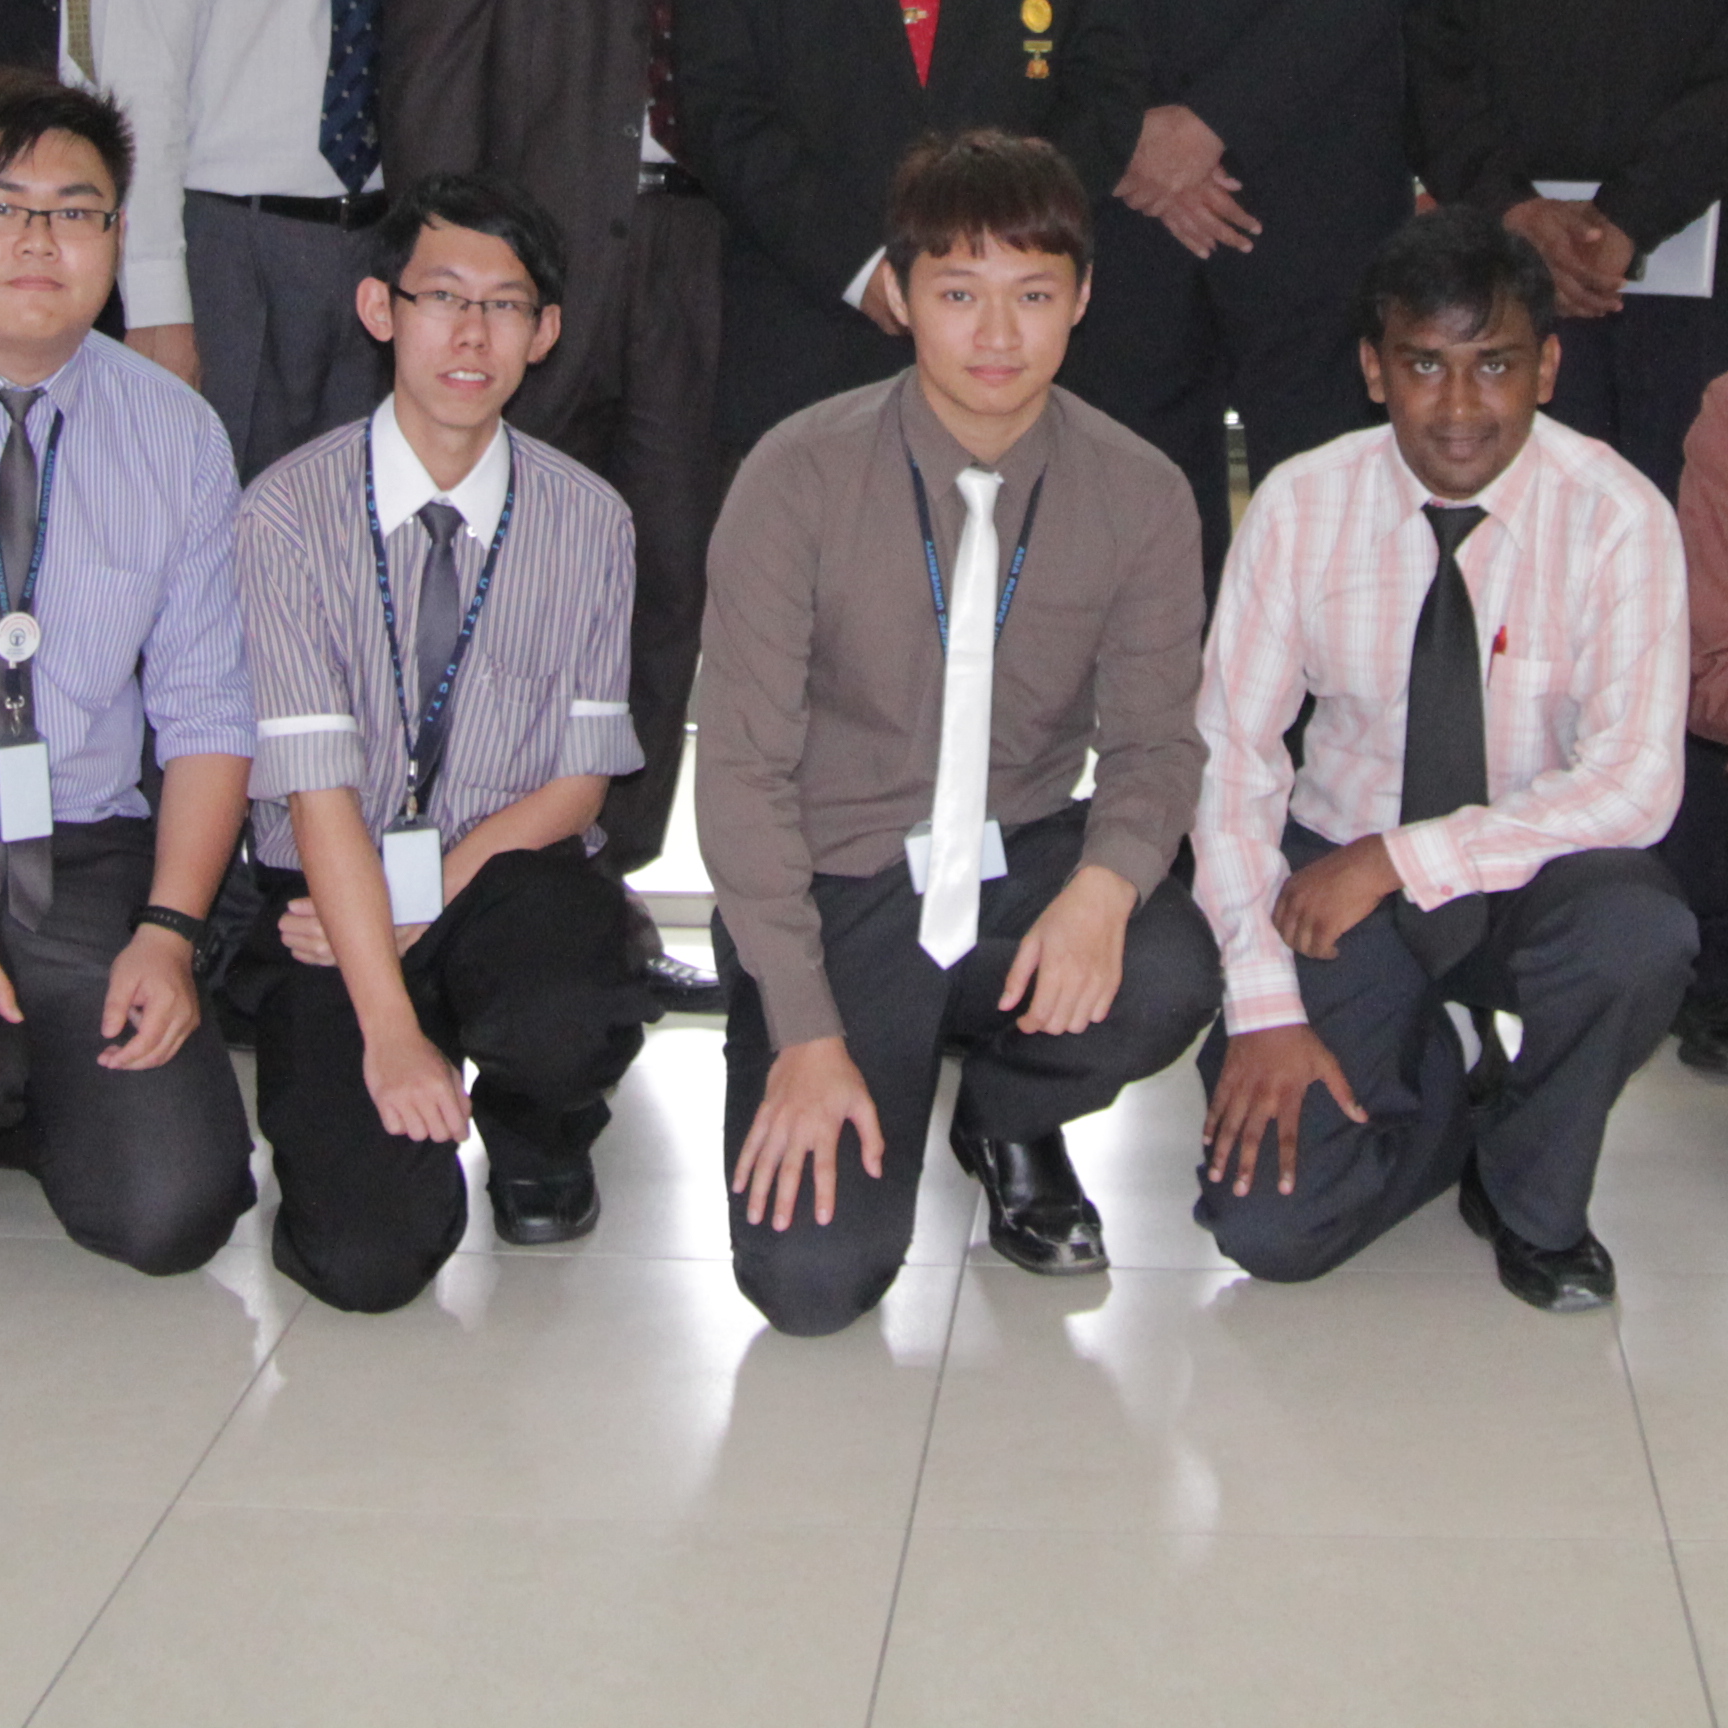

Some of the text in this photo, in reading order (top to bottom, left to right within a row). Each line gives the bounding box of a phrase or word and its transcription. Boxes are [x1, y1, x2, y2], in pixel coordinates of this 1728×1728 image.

[23, 449, 55, 599] ASIA PACIFIC UNIVERSITY
[366, 470, 379, 530] UCTI
[492, 492, 514, 549] UCTI
[926, 541, 944, 611] UNIVERSITY
[1011, 546, 1025, 574] ASIA
[377, 561, 394, 622] UCTI
[462, 578, 489, 635] UCTI
[997, 578, 1017, 624] PACIFIC
[426, 664, 457, 721] UCTI
